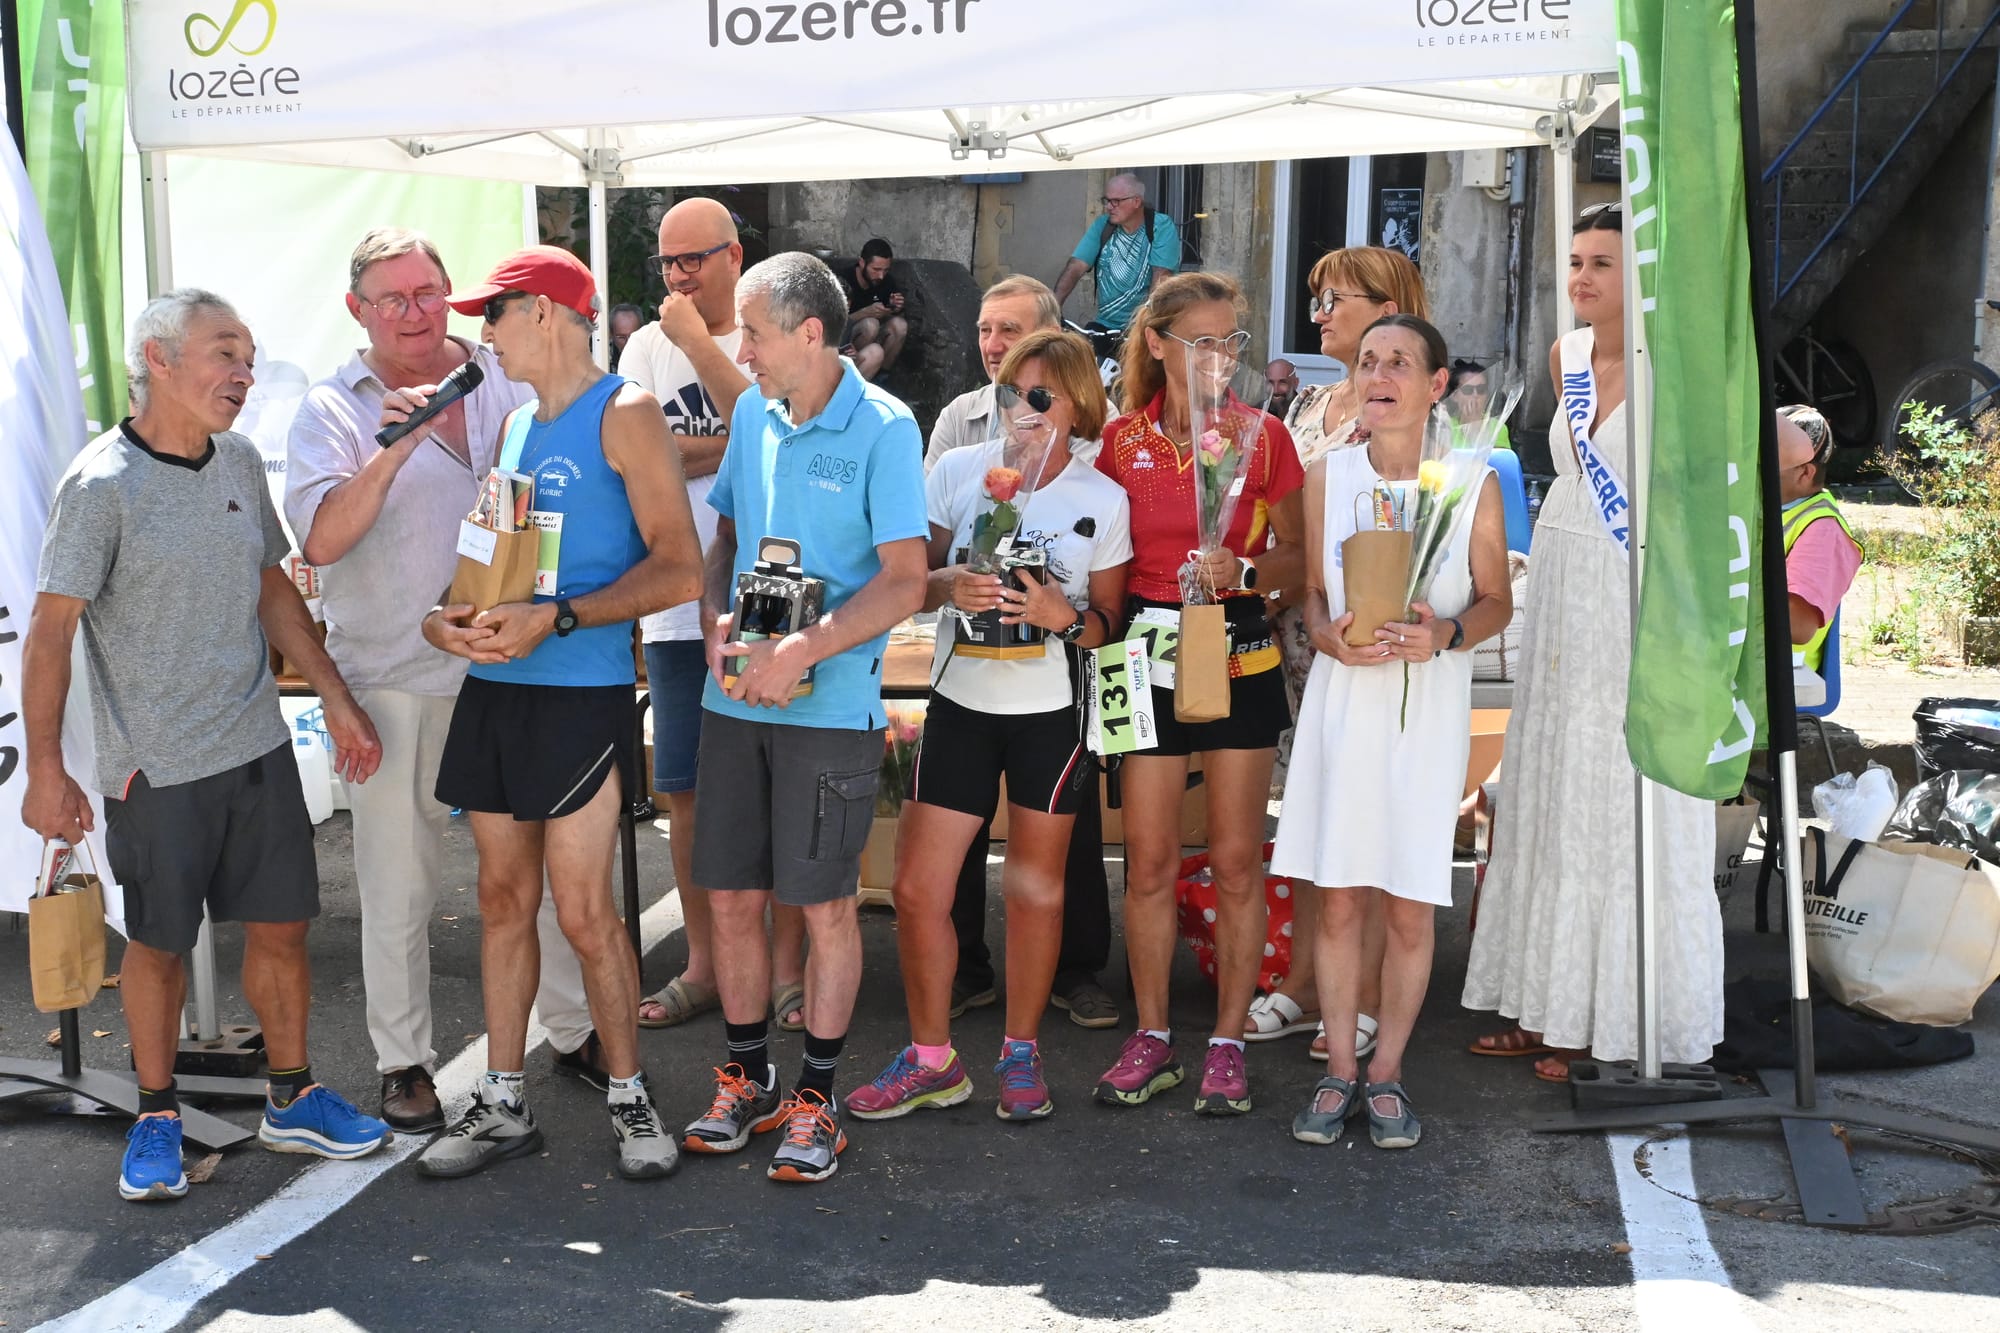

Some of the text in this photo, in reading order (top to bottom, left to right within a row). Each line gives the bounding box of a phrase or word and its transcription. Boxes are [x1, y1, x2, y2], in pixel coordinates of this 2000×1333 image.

[1417, 29, 1571, 47] LE DÉPARTEMENT
[169, 63, 300, 101] lozère
[172, 103, 303, 119] LE DÉPARTEMENT
[807, 453, 858, 484] ALPS
[1574, 425, 1629, 523] OZERE
[1100, 663, 1130, 736] 131
